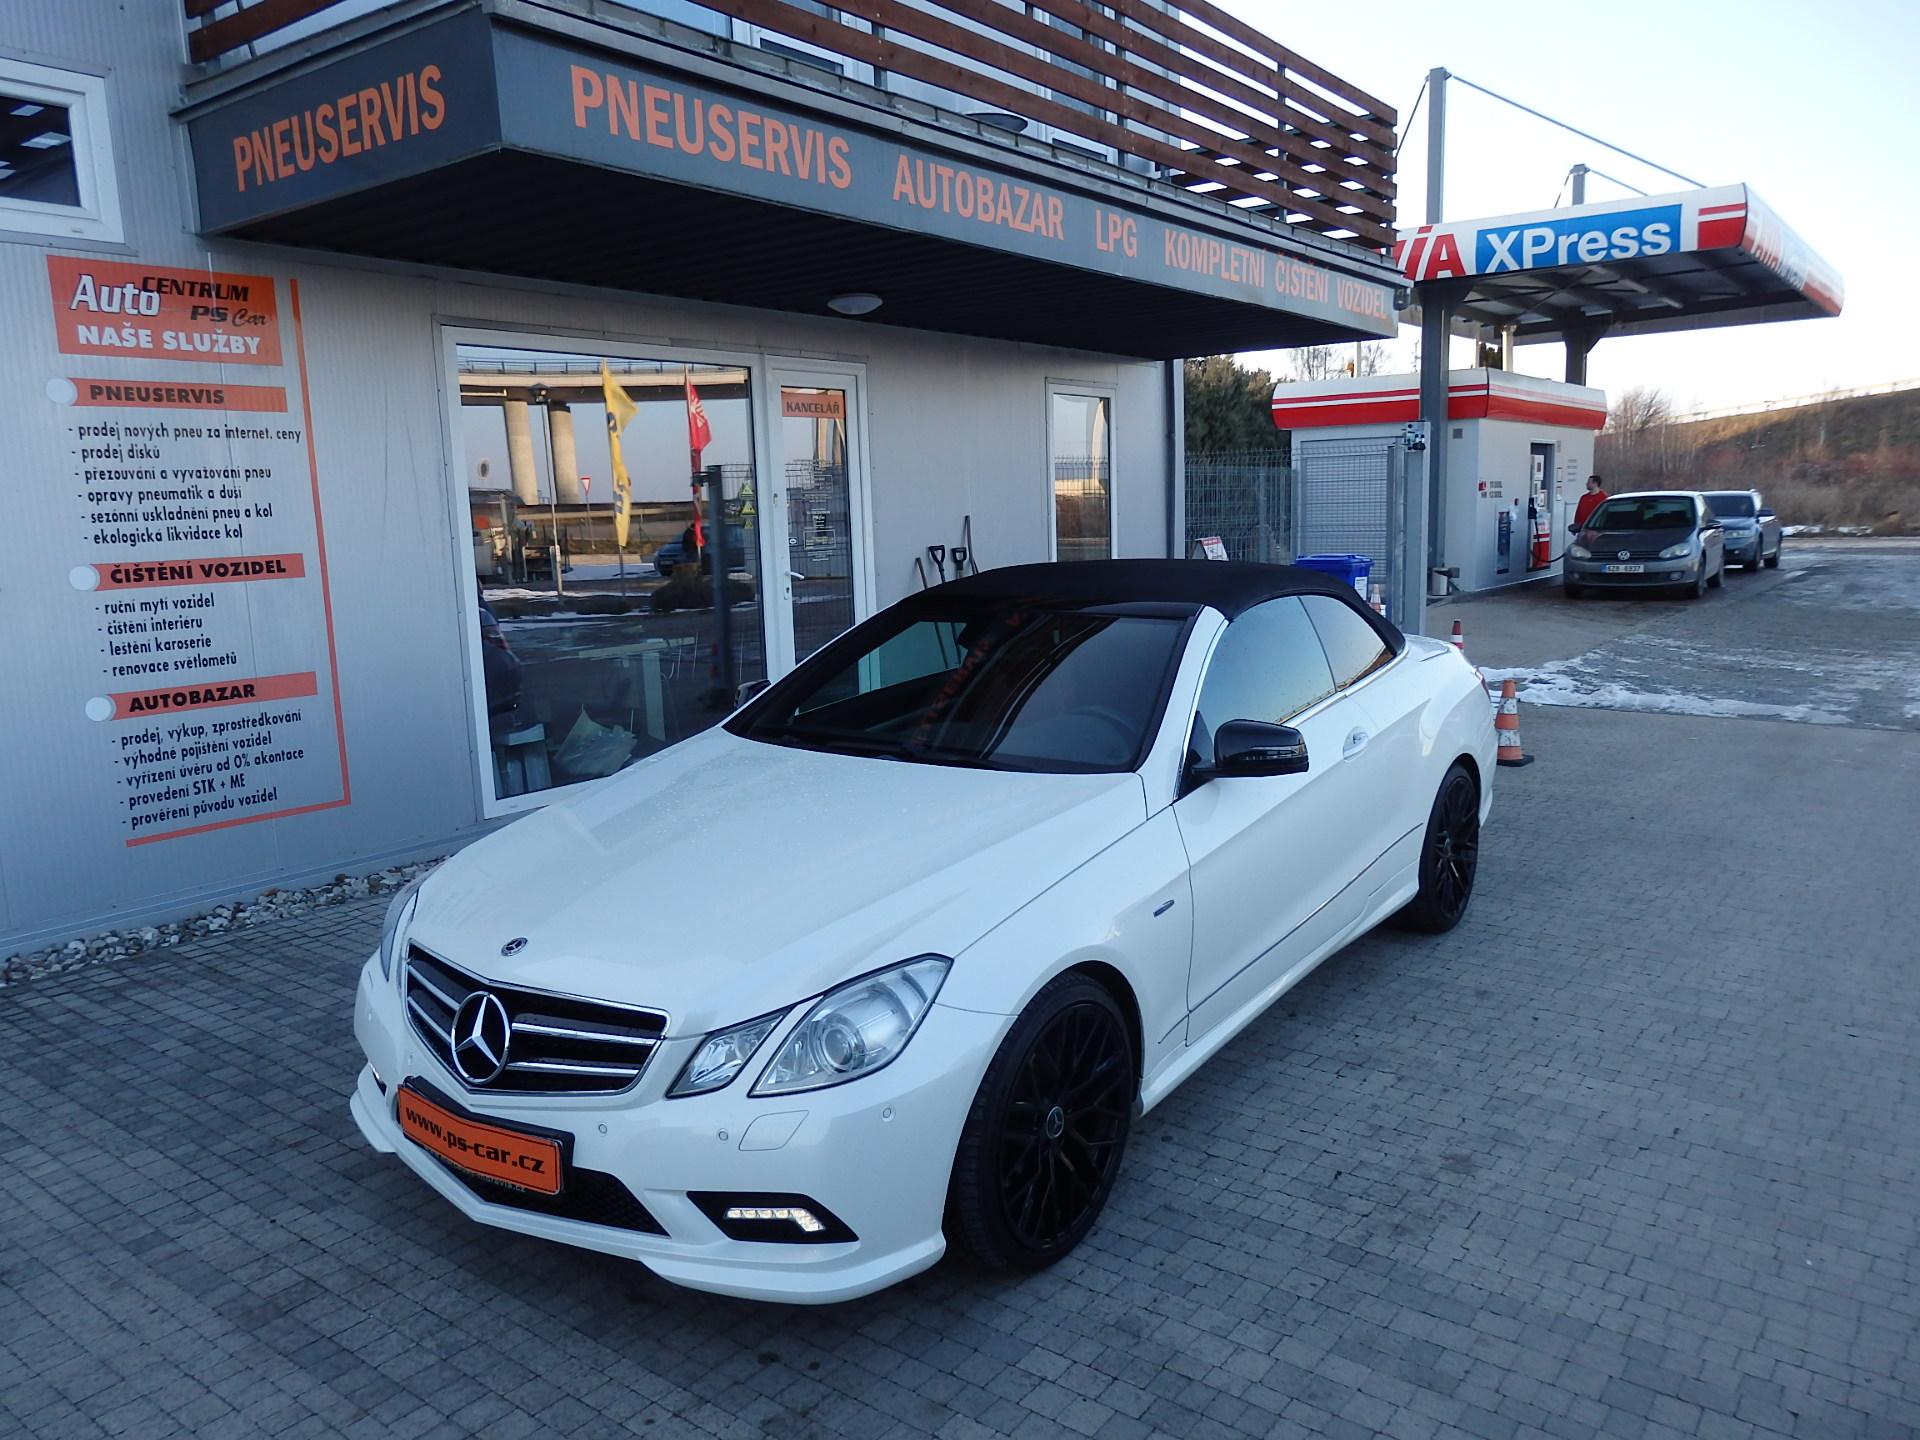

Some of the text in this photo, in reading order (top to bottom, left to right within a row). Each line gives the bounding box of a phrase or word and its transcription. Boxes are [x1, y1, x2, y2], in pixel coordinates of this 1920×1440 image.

[233, 64, 445, 192] PNEUSERVIS
[570, 64, 852, 188] PNEUSERVIS
[893, 154, 1064, 240] AUTOBAZAR
[1094, 209, 1138, 258] LPG
[1164, 228, 1265, 289] KOMPLETNÍ
[1336, 278, 1387, 320] VOZIDEL
[1484, 222, 1671, 274] XPress
[69, 273, 249, 317] Auto CENTRUM
[190, 305, 266, 327] PS Car
[77, 322, 260, 354] NAŠE SLUŽBY
[90, 385, 224, 404] PNEUSERVIS
[79, 422, 120, 440] prodej
[174, 427, 201, 440] pneu
[207, 428, 220, 438] za
[277, 429, 301, 443] ceny
[82, 443, 123, 462] prodej
[160, 470, 167, 479] a
[245, 467, 271, 481] pneu
[88, 489, 132, 505] opravy
[138, 485, 203, 504] pneumatik
[208, 489, 215, 498] a
[213, 509, 240, 522] pneu
[245, 509, 250, 518] a
[255, 503, 272, 517] kol
[94, 524, 242, 546] ekologická likvidace kol
[110, 560, 286, 584] ČIŠTĚNÍ VOZIDEL
[104, 599, 136, 614] ruční
[173, 592, 214, 609] vozidel
[108, 615, 202, 635] čištění interiéru
[110, 634, 211, 656] leštění karoserie
[112, 652, 237, 676] renovace světlometů
[129, 684, 256, 712] AUTOBAZAR
[121, 727, 163, 750] prodej,
[124, 731, 272, 769] výhodné pojištění vozidel
[180, 762, 212, 778] úvěru
[216, 758, 230, 771] od
[234, 753, 250, 769] 0%
[254, 749, 304, 766] akontace
[129, 787, 189, 810] provedení
[193, 778, 216, 795] STK
[231, 773, 245, 789] ME
[131, 787, 277, 830] prověření původu vozidel
[405, 1107, 545, 1174] www.ps-car.cz
